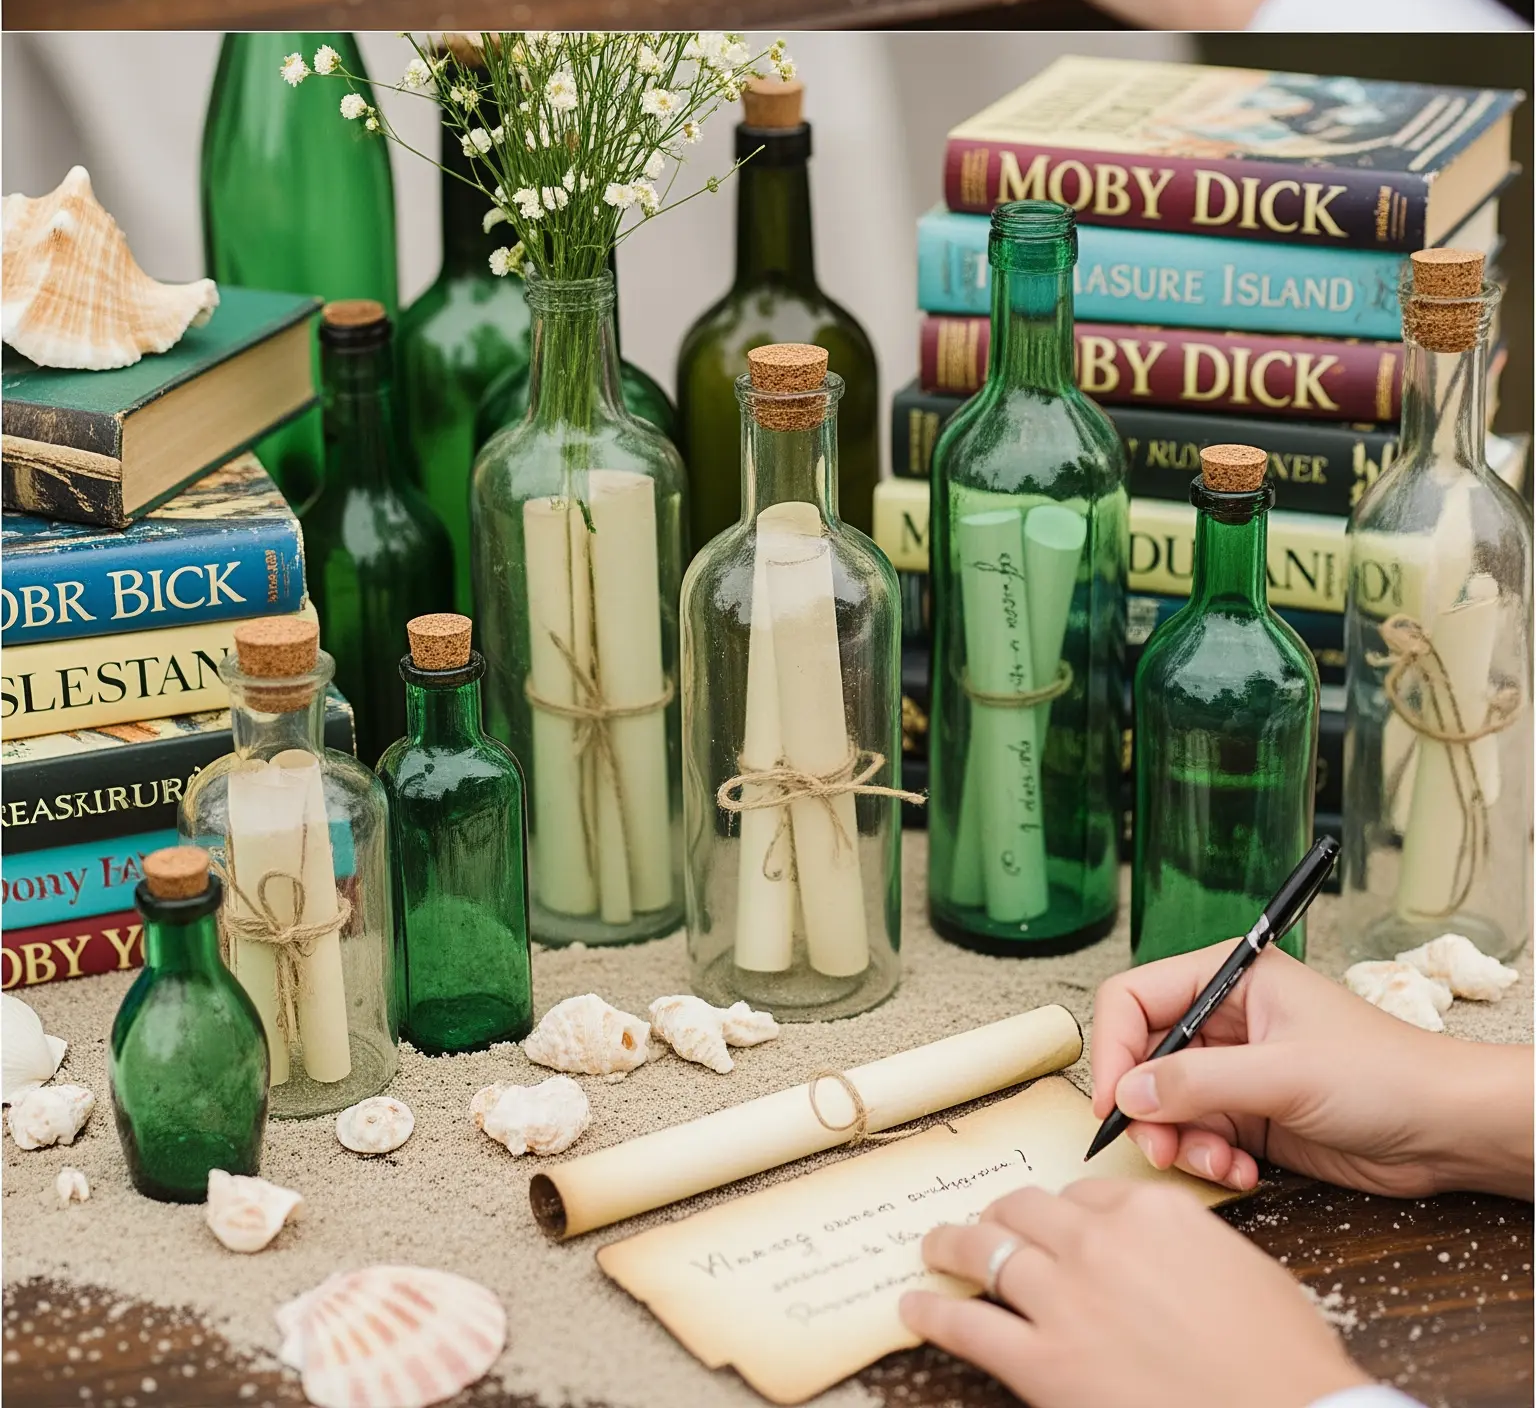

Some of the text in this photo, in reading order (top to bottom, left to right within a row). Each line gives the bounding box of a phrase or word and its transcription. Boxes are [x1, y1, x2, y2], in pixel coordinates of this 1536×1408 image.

[998, 151, 1175, 221] MOBY
[1192, 169, 1350, 238] DICK
[1224, 264, 1354, 312] ISLAND
[1181, 342, 1340, 411] DICK
[107, 561, 247, 621] BICK
